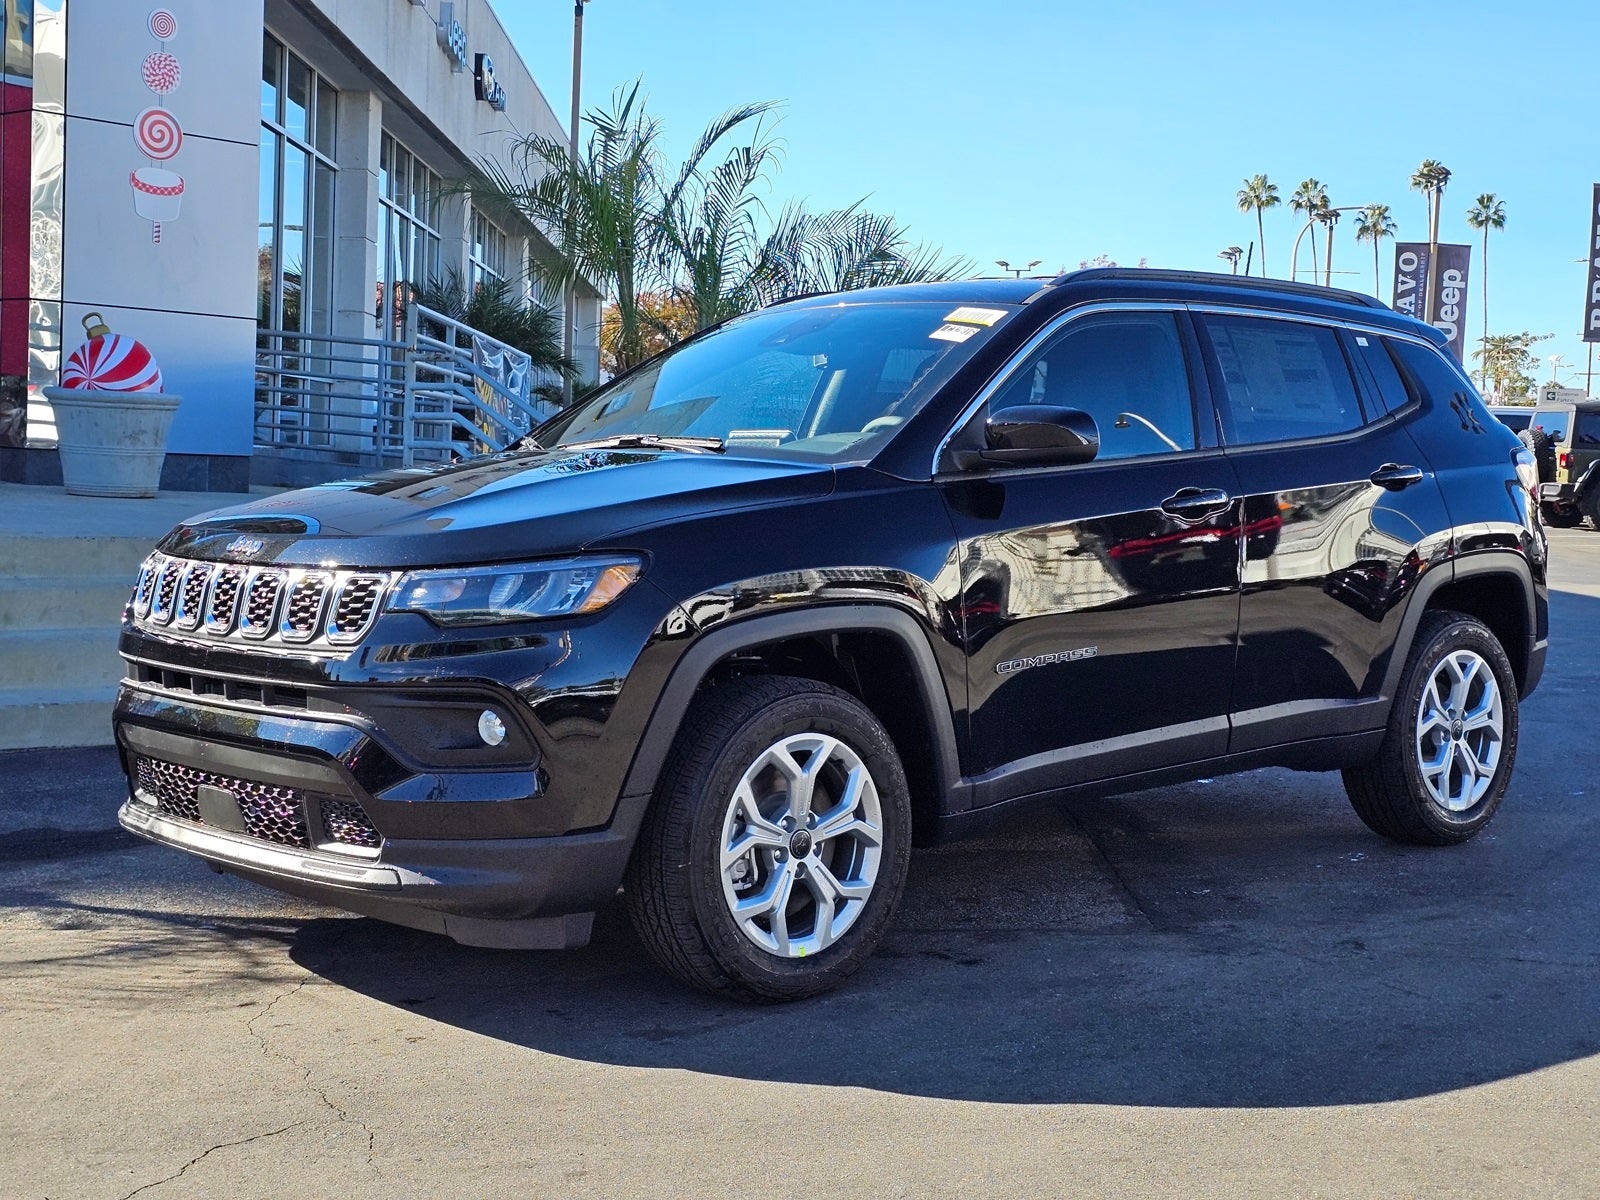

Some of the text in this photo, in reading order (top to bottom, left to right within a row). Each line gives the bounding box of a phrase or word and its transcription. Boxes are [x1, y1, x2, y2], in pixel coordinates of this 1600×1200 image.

[444, 1, 467, 68] Jeep
[1396, 251, 1418, 318] AVO
[1433, 268, 1466, 341] Jeep
[226, 534, 264, 557] Jeep
[996, 645, 1098, 675] COMPASS
